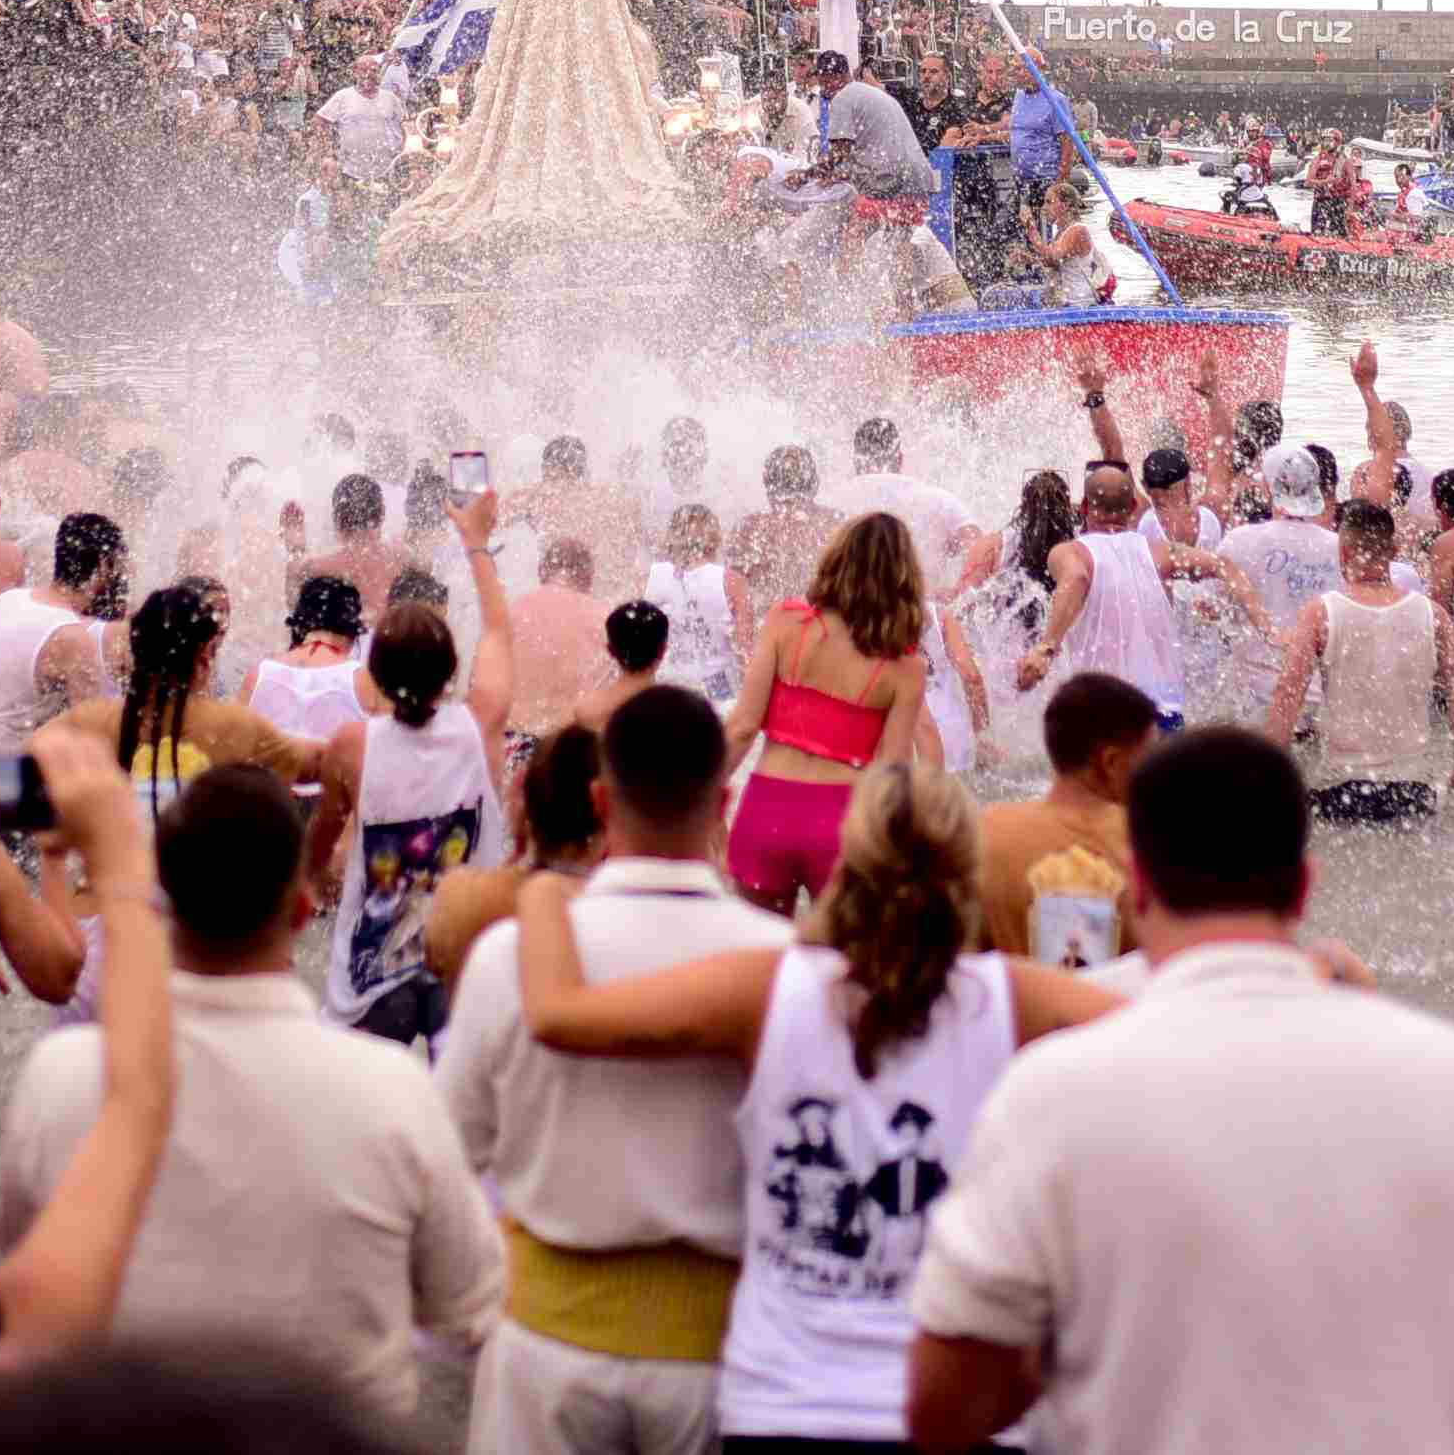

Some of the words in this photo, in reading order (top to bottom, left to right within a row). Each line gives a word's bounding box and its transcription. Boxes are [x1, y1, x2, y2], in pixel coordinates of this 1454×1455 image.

[1043, 7, 1156, 41] Puerto
[1175, 10, 1217, 42] de
[1233, 10, 1261, 42] la
[1276, 10, 1353, 44] Cruz
